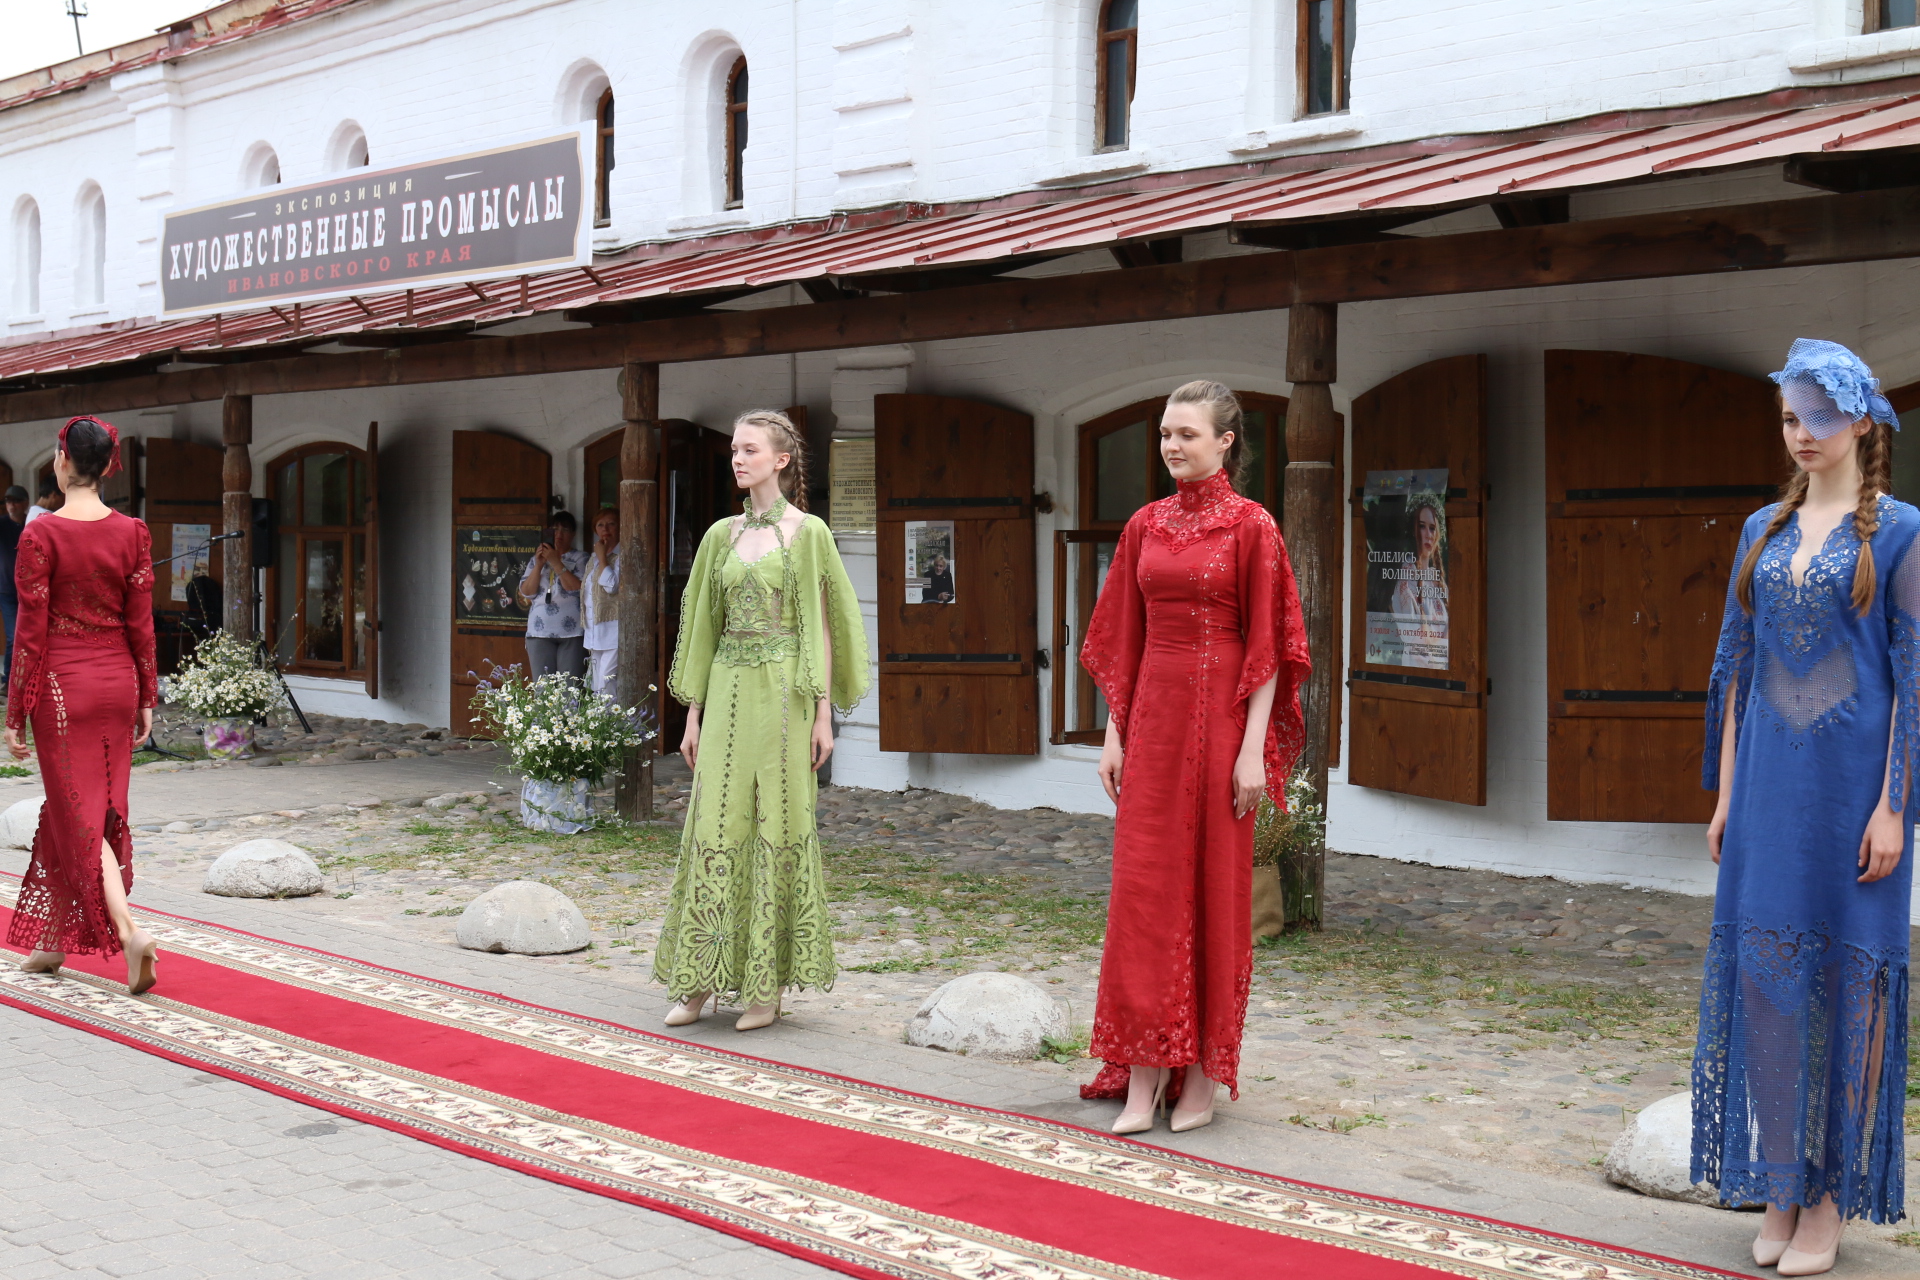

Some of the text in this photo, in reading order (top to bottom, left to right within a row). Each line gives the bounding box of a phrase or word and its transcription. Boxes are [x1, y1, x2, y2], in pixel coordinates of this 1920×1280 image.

[274, 178, 413, 215] ЭКСПОЗИЦИЯ
[169, 175, 565, 282] ХУДОЖЕСТВЕННЫЕ ПРОМЫСЛЫ
[227, 244, 472, 294] ИВАНОВСКОГО КРАЯ
[462, 543, 536, 555] Художественный салон
[1367, 551, 1417, 564] СПЛЕЛИСЬ
[1382, 568, 1441, 581] ВОЛШЕБНЫЕ
[1416, 586, 1448, 599] УЗОРЫ
[1402, 628, 1428, 639] октября
[1429, 631, 1445, 639] 2022
[1369, 643, 1382, 657] 0+
